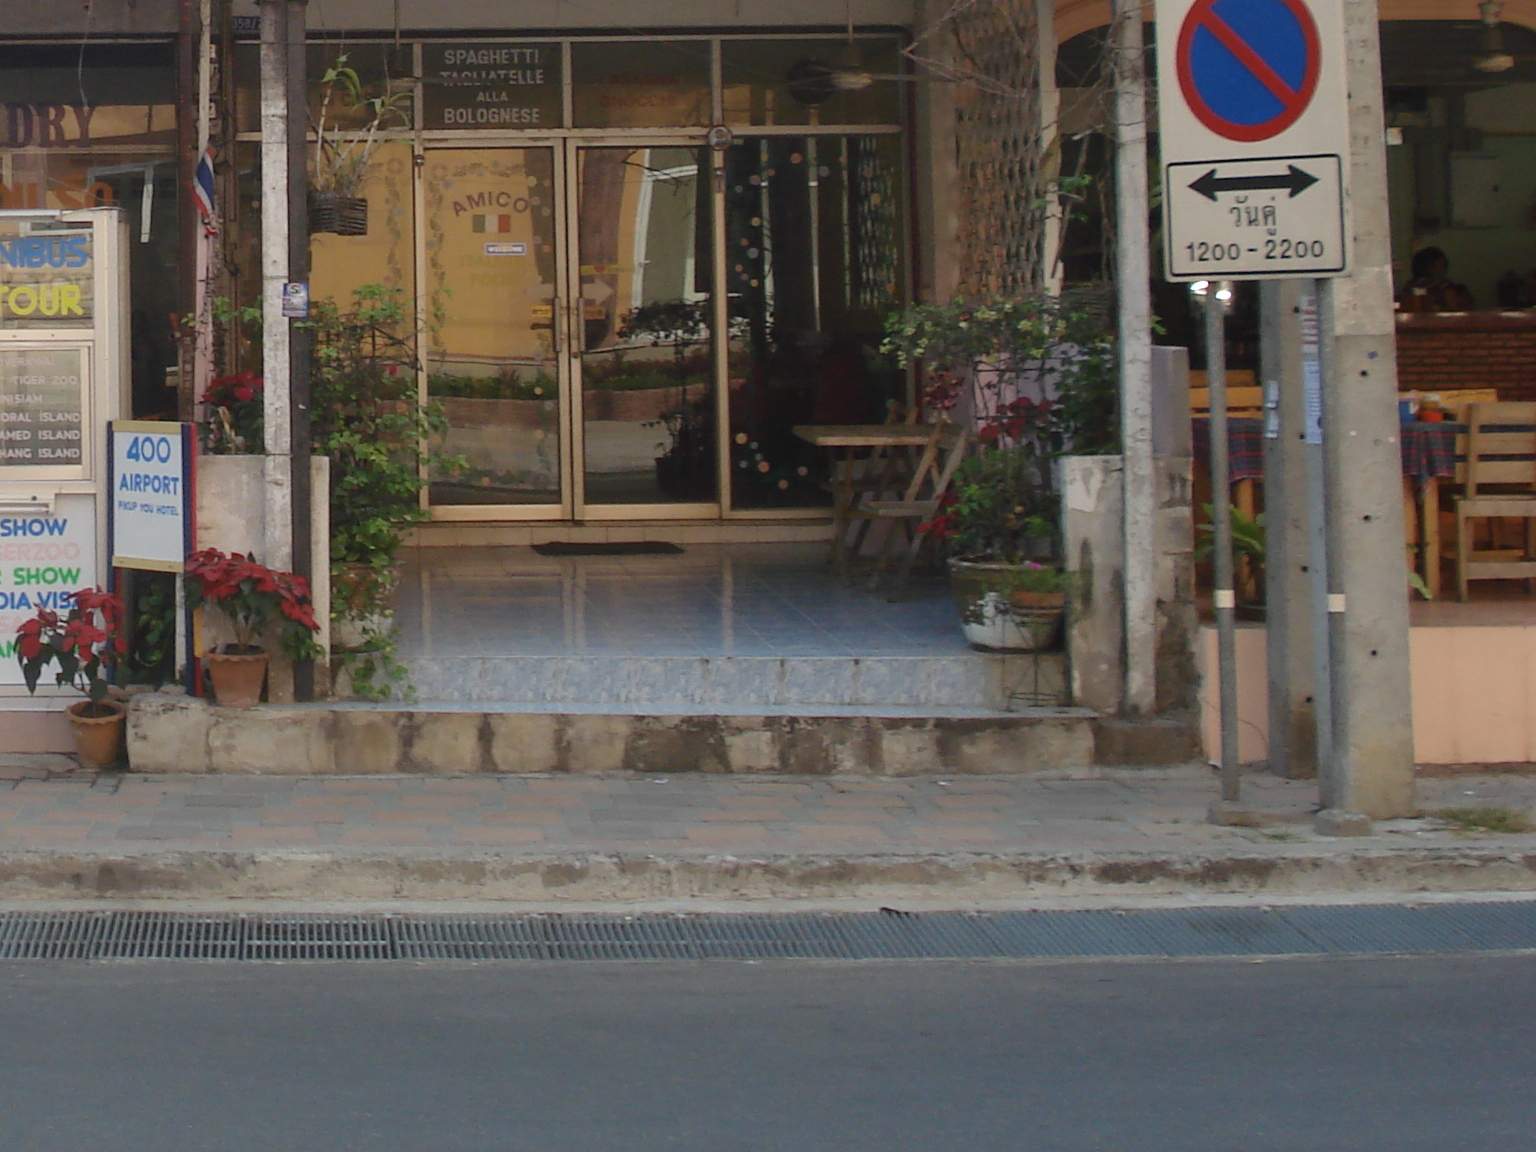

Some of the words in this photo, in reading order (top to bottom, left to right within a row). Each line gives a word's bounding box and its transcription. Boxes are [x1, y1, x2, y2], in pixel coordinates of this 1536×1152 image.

[444, 49, 539, 65] SPAGHETTI
[476, 91, 508, 103] ALLA
[444, 108, 540, 124] BOLOGNESE
[452, 192, 529, 217] AMICO
[1229, 195, 1277, 237] วันคู่
[12, 375, 46, 385] TIGER
[51, 375, 78, 386] ZOO
[39, 412, 81, 423] ISLAND
[38, 430, 80, 441] ISLAND
[38, 448, 80, 459] ISLAND
[125, 436, 172, 464] 400
[119, 473, 180, 496] AIRPORT
[140, 502, 155, 514] YOU
[156, 504, 180, 516] HOTEL
[0, 518, 68, 537] SHOW
[13, 567, 82, 586] SHOW
